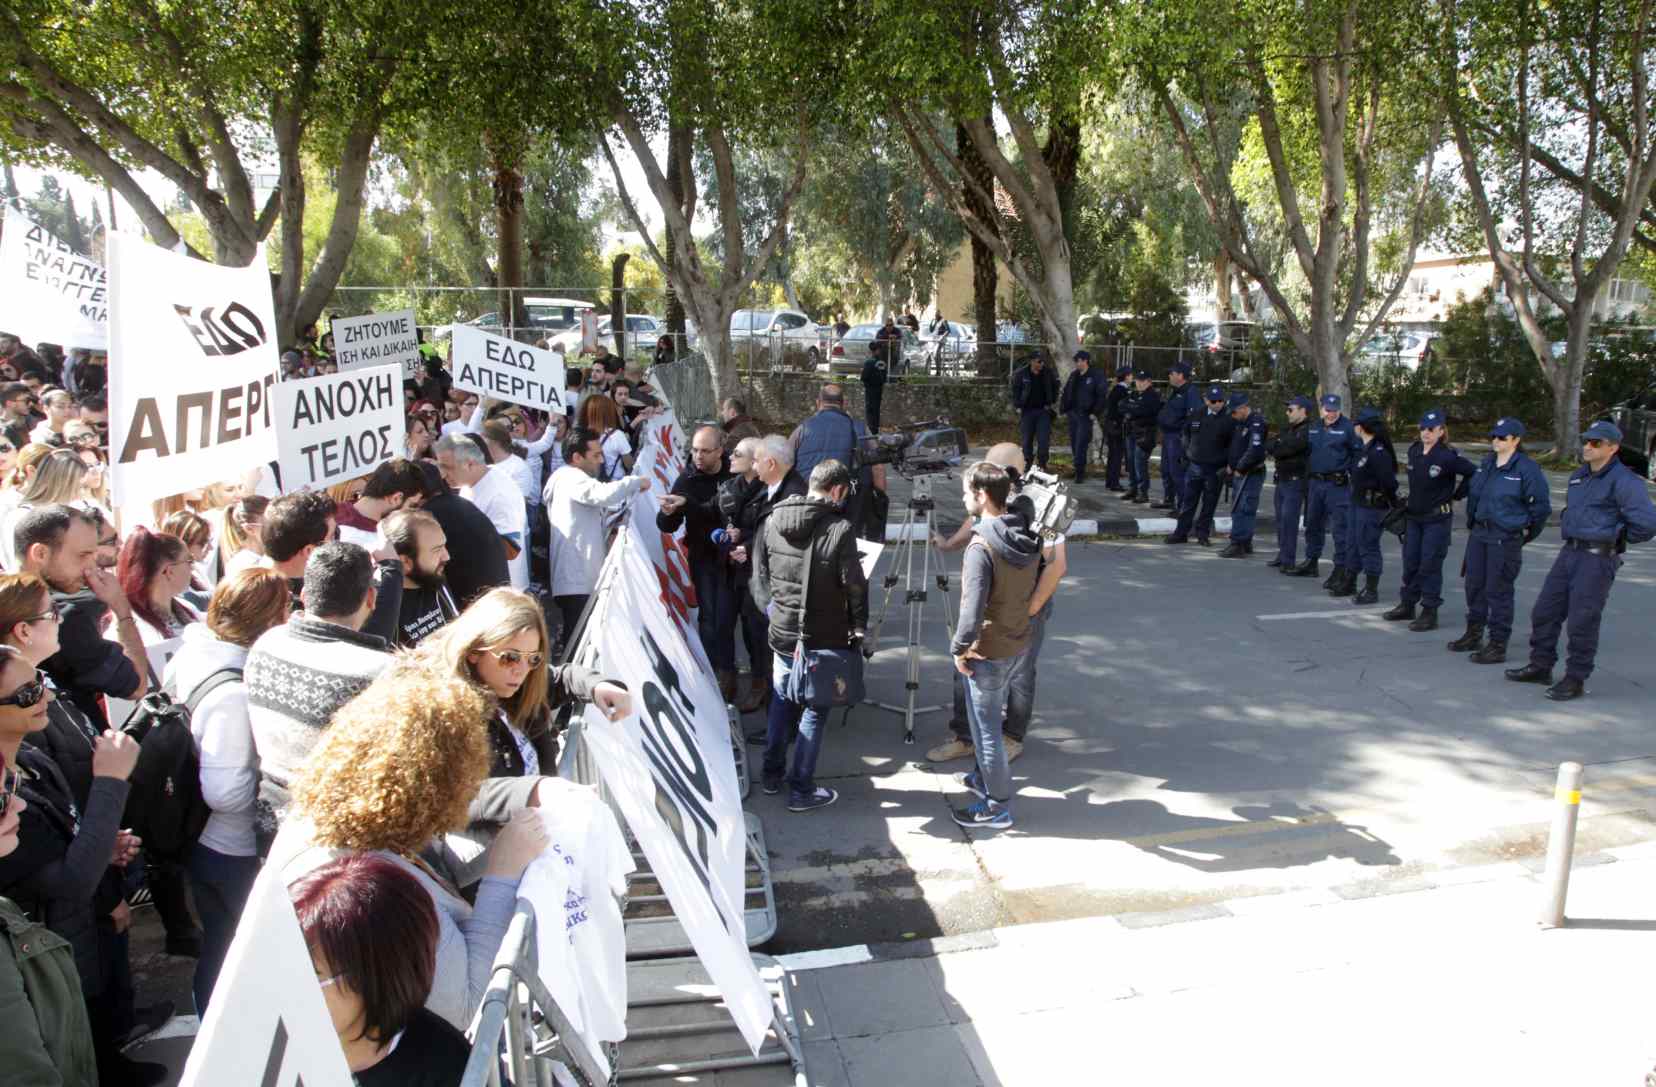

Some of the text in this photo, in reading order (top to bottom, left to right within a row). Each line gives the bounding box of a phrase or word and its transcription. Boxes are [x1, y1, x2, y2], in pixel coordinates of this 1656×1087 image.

[172, 300, 268, 357] ΕΔΩ
[343, 318, 409, 344] ΖΗΤΟΥΜΕ
[361, 345, 380, 360] ΚΑΙ
[486, 338, 536, 372] ΕΔΩ
[292, 372, 393, 430] ΑΝΟΧΗ
[459, 363, 562, 408] ΑΠΕΡΓΙΑ
[118, 369, 280, 463] ΑΠΕΡΓ
[301, 424, 394, 483] ΤΕΛΟΣ
